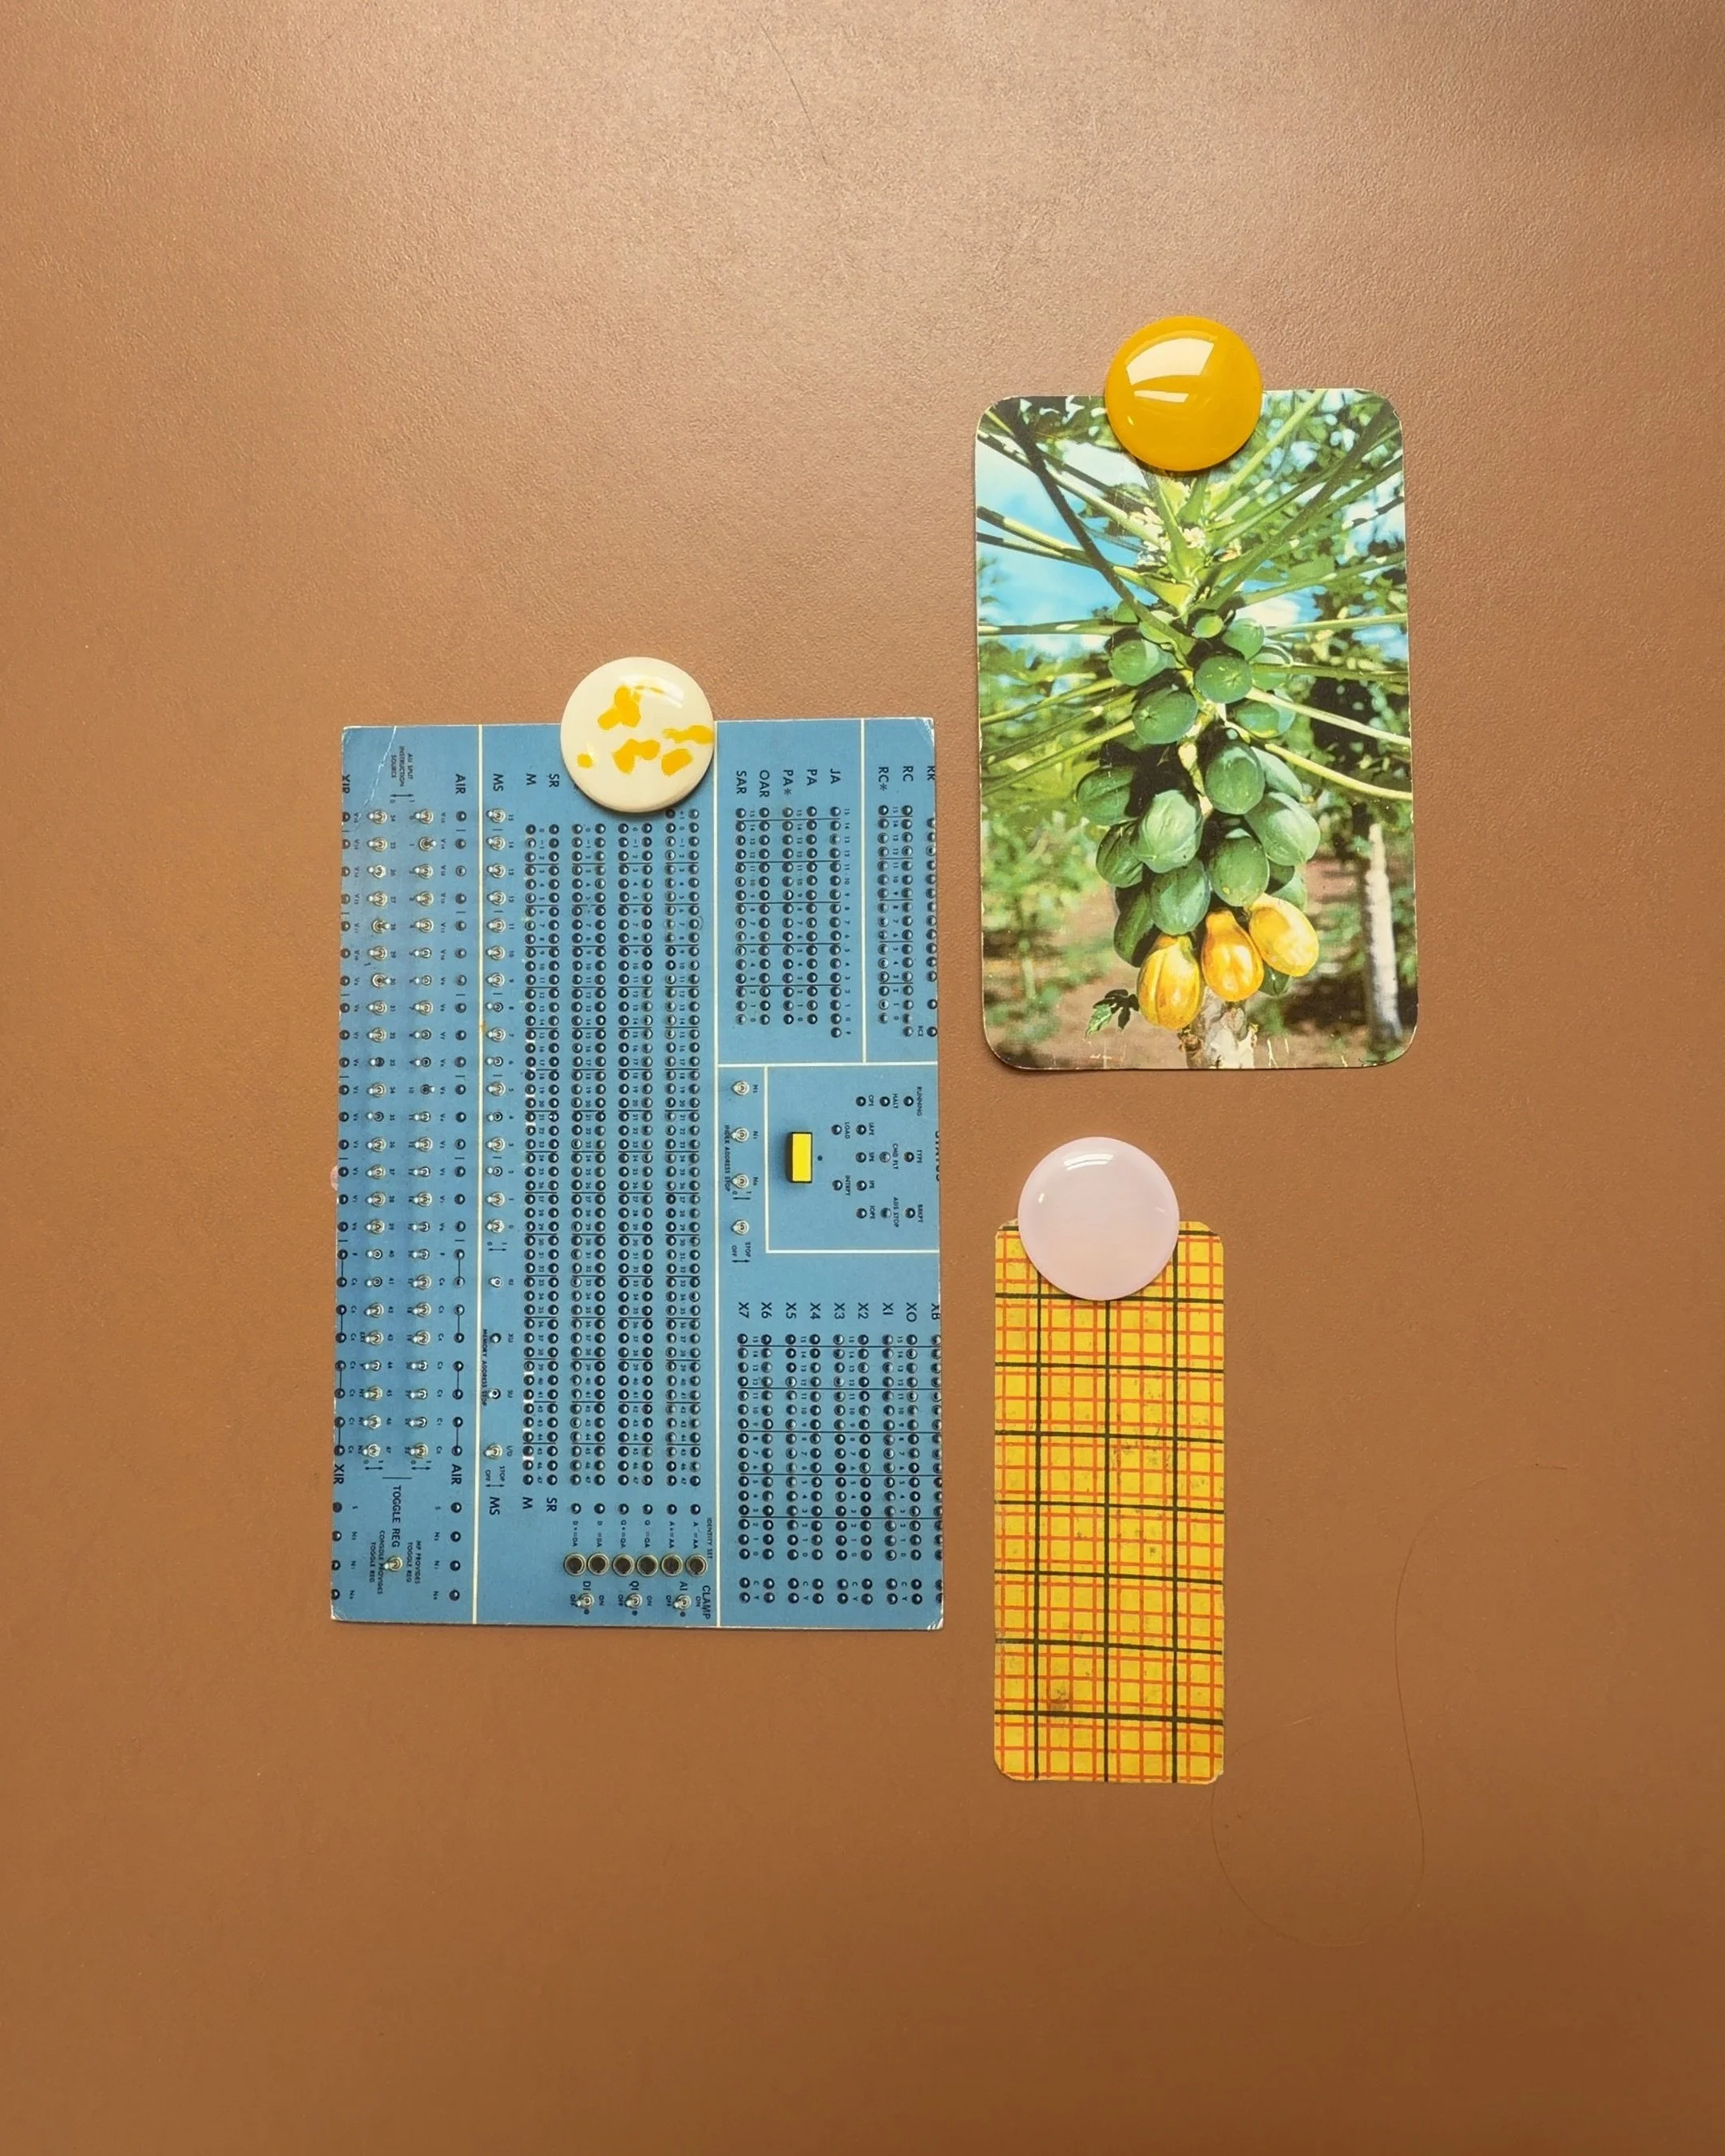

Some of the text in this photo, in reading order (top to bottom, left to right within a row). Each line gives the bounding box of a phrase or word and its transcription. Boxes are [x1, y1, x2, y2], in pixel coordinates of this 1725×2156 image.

[493, 773, 503, 792] MS
[526, 773, 536, 786] M
[549, 773, 559, 788] SR
[736, 770, 747, 795] SAR
[806, 769, 816, 786] PA
[830, 768, 841, 784] JA
[902, 766, 913, 782] RC
[455, 774, 466, 795] AIR
[759, 770, 770, 798] OAR
[738, 1302, 748, 1318] X7
[761, 1302, 772, 1319] X6
[785, 1302, 796, 1319] X5
[809, 1302, 820, 1320] X4
[834, 1302, 845, 1319] X3
[858, 1302, 869, 1319] X2
[333, 1463, 345, 1485] XIR
[450, 1464, 462, 1485] AIR
[489, 1496, 500, 1516] MS
[521, 1496, 532, 1509] M
[545, 1497, 557, 1512] SR
[391, 1485, 402, 1548] TOGGLE REG
[598, 1595, 605, 1606] ON
[646, 1595, 652, 1607] ON
[696, 1595, 702, 1607] ON
[701, 1585, 712, 1619] CLAMP
